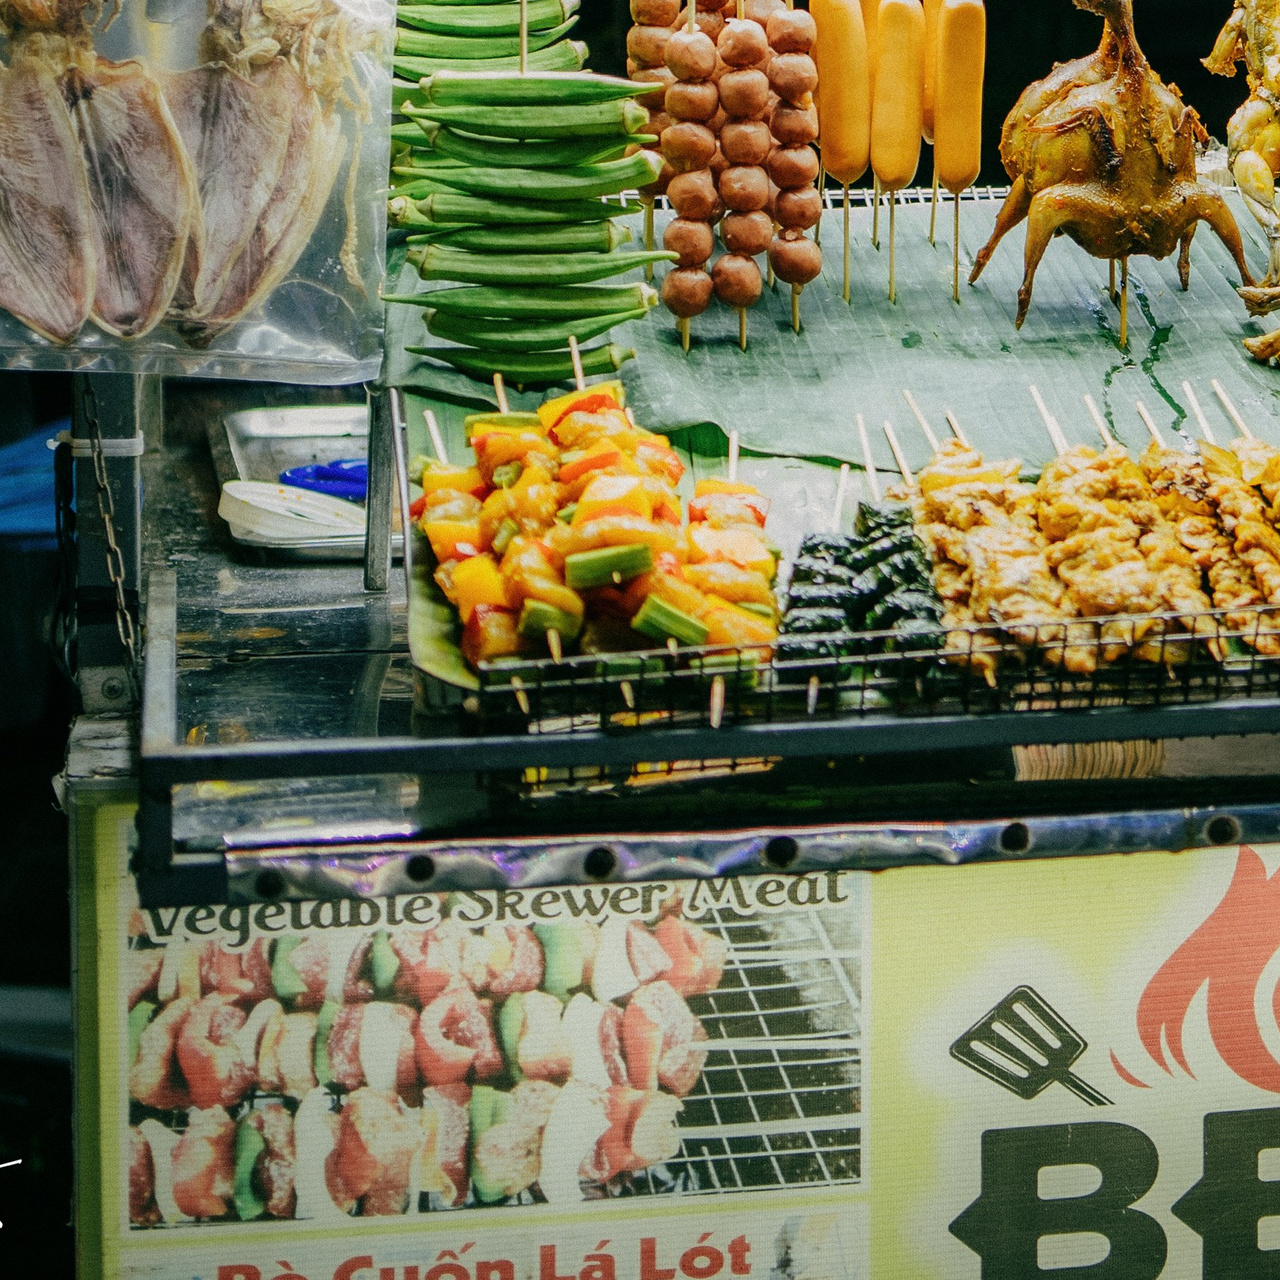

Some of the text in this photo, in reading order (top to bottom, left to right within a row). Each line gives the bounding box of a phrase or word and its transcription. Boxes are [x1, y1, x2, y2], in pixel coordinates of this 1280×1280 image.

[150, 870, 849, 948] Vegetable Skewer Meat
[539, 1238, 616, 1280] Lá
[639, 1231, 752, 1280] Lót
